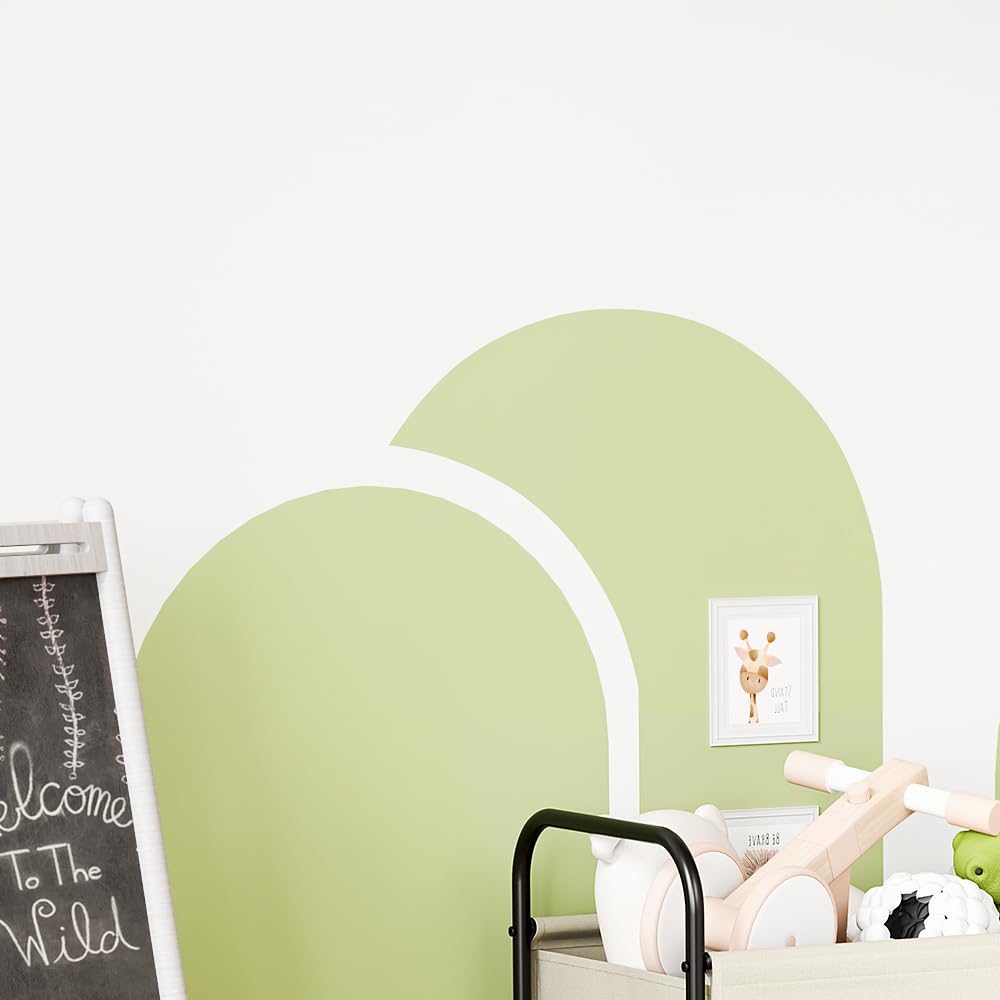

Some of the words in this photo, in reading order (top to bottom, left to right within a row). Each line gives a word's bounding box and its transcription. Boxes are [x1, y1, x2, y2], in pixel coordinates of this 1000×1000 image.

[0, 743, 134, 837] elcome
[0, 849, 40, 891] To
[36, 842, 102, 886] The
[0, 895, 141, 967] Wild
